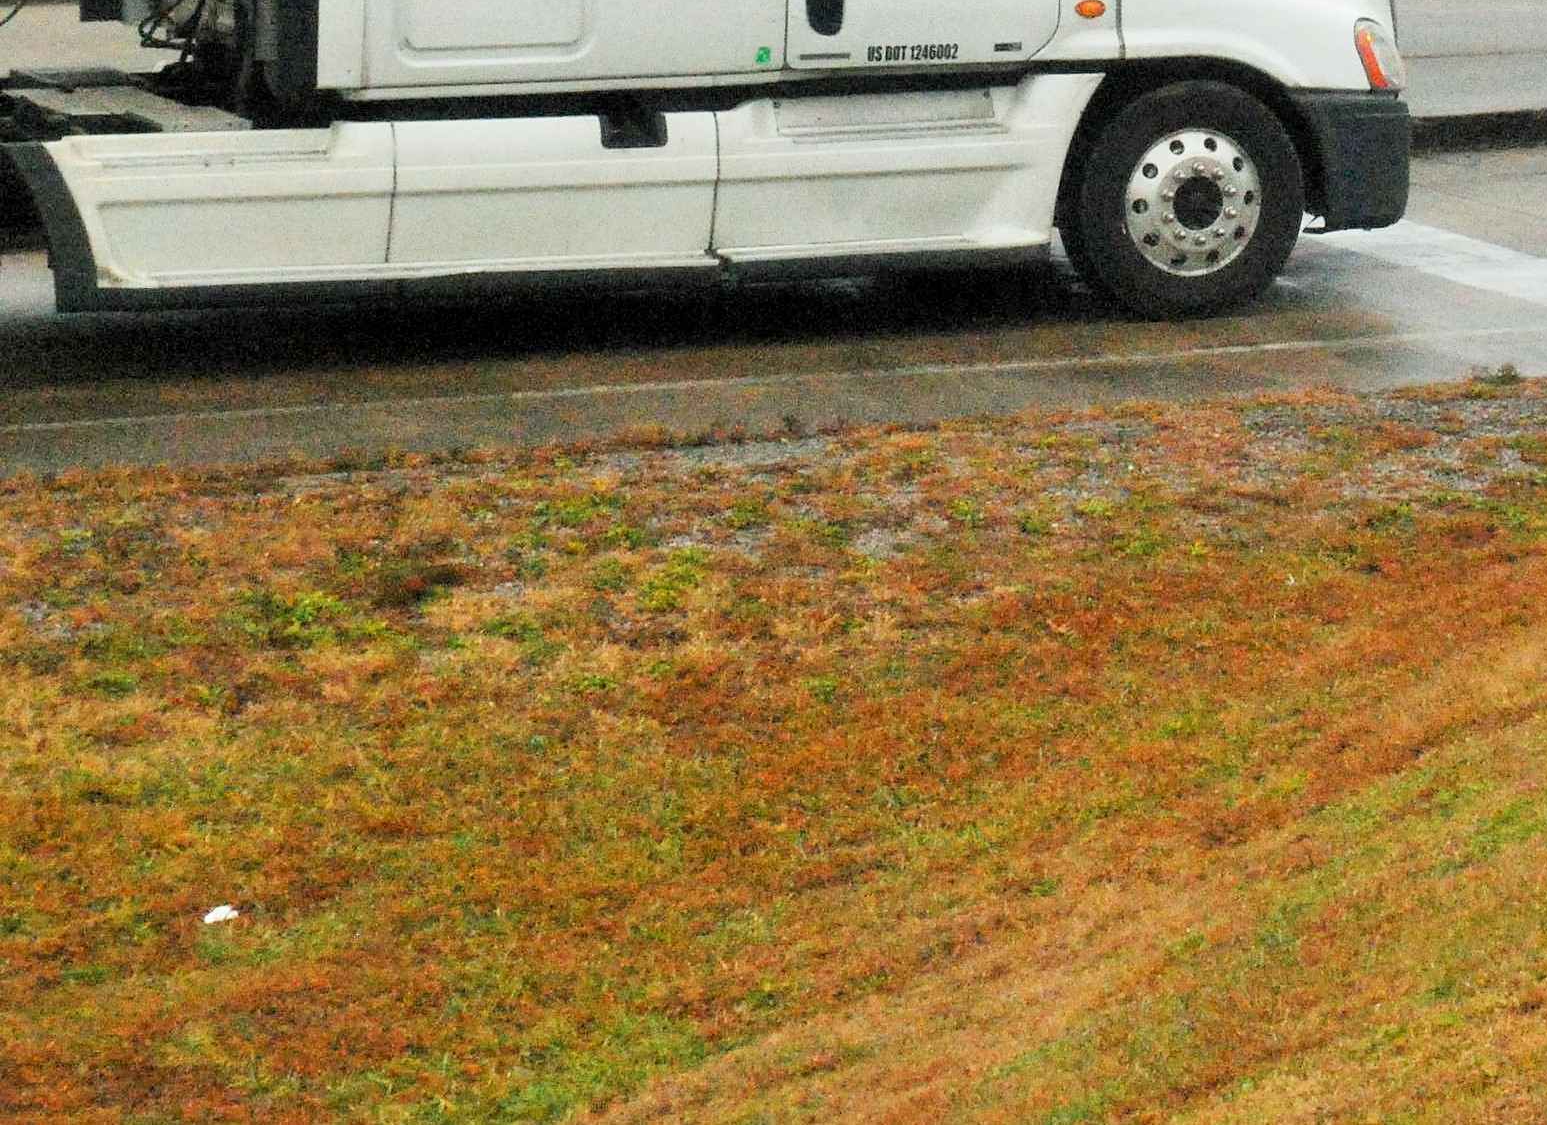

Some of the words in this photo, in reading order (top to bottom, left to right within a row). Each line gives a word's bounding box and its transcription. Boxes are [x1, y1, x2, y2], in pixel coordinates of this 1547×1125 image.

[867, 45, 883, 62] US
[885, 44, 907, 61] DOT
[910, 42, 959, 61] 1246002
